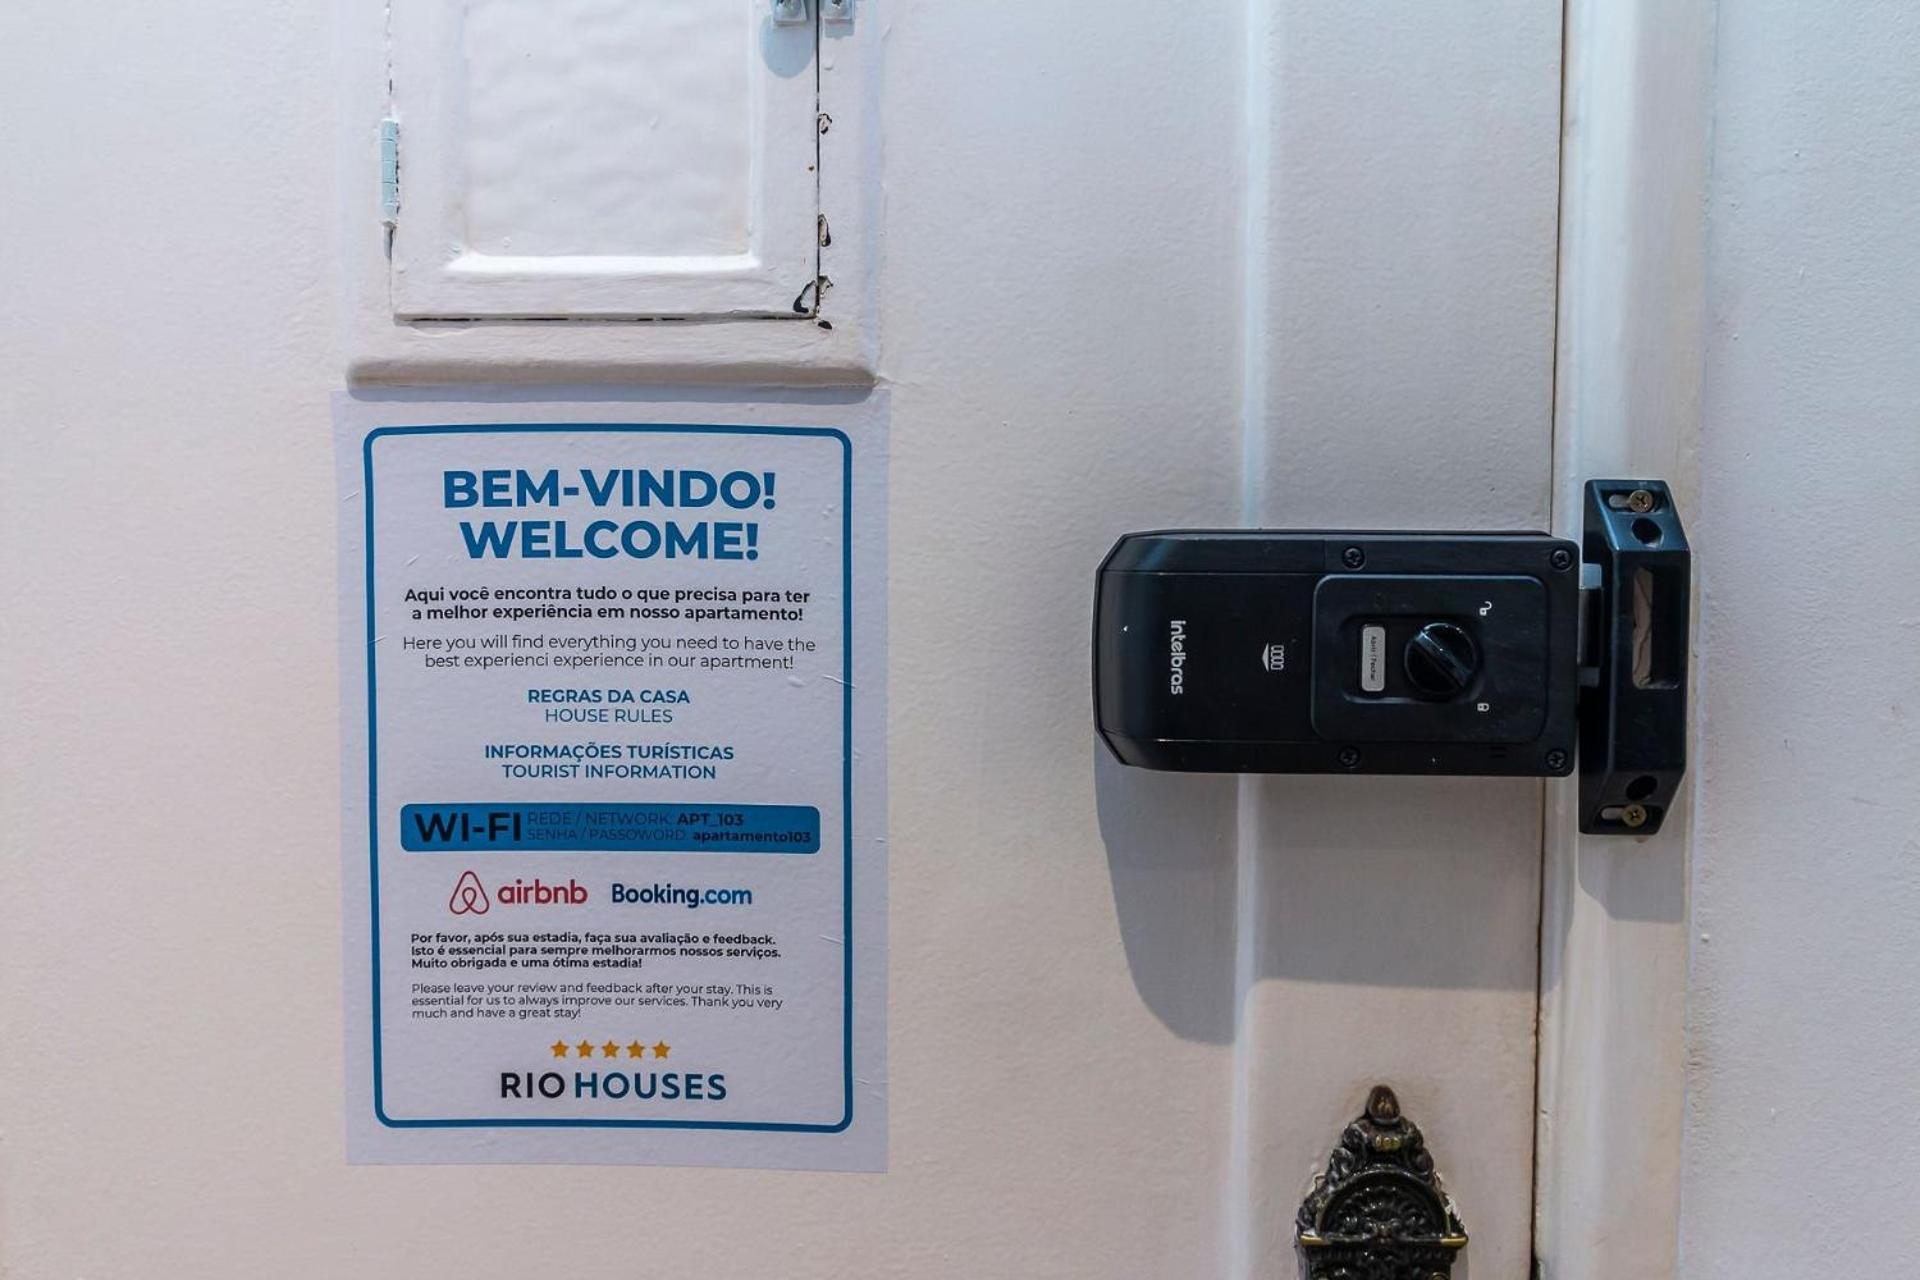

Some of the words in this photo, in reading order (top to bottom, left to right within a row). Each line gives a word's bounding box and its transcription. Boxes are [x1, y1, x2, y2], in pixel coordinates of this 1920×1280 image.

[444, 470, 775, 509] BEM-VINDO!
[460, 520, 758, 560] WELCOME!
[405, 587, 444, 604] Aqui
[449, 587, 489, 600] você
[495, 588, 571, 599] encontra
[576, 586, 617, 599] tudo
[622, 590, 632, 599] o
[637, 590, 670, 603] que
[675, 587, 736, 603] precisa
[743, 591, 780, 604] para
[785, 591, 810, 603] ter
[412, 610, 421, 619] a
[427, 605, 488, 619] melhor
[493, 604, 592, 621] experiência
[598, 608, 624, 618] em
[630, 608, 680, 618] nosso
[685, 607, 802, 622] apartamento!
[404, 637, 442, 649] Here
[446, 639, 475, 652] you
[480, 635, 507, 648] will
[512, 635, 543, 648] find
[549, 635, 636, 652] everything
[641, 638, 671, 652] you
[677, 636, 717, 649] need
[722, 638, 739, 649] to
[745, 636, 783, 650] have
[788, 637, 815, 651] the
[426, 654, 460, 667] best
[464, 653, 548, 670] experienci
[554, 653, 644, 669] experience
[649, 653, 663, 666] in
[668, 656, 696, 667] our
[701, 656, 793, 670] apartment!
[1170, 620, 1186, 695] intelbras
[529, 689, 602, 703] REGRAS
[608, 690, 635, 703] DA
[640, 690, 690, 703] CASA
[546, 709, 608, 722] HOUSE
[615, 709, 672, 723] RULES
[486, 742, 622, 762] INFORMAÇÕES
[627, 742, 734, 759] TURÍSTICAS
[502, 765, 580, 778] TOURIST
[586, 765, 715, 779] INFORMATION
[415, 813, 521, 841] WI-FI
[677, 814, 743, 827] APT_103
[527, 829, 576, 840] SENHA
[498, 879, 588, 904] airbnb
[612, 883, 752, 908] Booking.com
[411, 934, 432, 943] Por
[436, 933, 471, 944] favor,
[474, 932, 504, 944] após
[533, 932, 581, 944] estadia,
[585, 932, 611, 945] faça
[640, 933, 699, 946] avaliação
[702, 936, 710, 944] e
[713, 934, 775, 944] feedback.
[412, 946, 434, 956] Isto
[437, 945, 445, 955] é
[448, 944, 506, 955] essencial
[510, 947, 537, 957] para
[541, 947, 588, 959] sempre
[592, 945, 676, 955] melhorarmos
[680, 948, 723, 956] nossos
[727, 946, 781, 959] serviços.
[412, 958, 447, 968] Muito
[451, 957, 506, 969] obrigada
[553, 956, 589, 967] ótima
[593, 957, 642, 968] estadia!
[412, 984, 451, 993] Please
[454, 983, 484, 992] leave
[487, 984, 514, 995] your
[518, 983, 557, 992] review
[560, 983, 583, 992] and
[586, 983, 642, 993] feedback
[646, 983, 673, 993] after
[676, 986, 703, 996] your
[706, 985, 733, 996] stay.
[736, 984, 761, 995] This
[764, 985, 772, 995] is
[412, 995, 464, 1006] essential
[467, 995, 483, 1005] for
[486, 997, 500, 1005] us
[503, 996, 515, 1005] to
[518, 995, 559, 1007] always
[562, 995, 612, 1007] improve
[638, 995, 688, 1006] services.
[691, 996, 729, 1006] Thank
[732, 999, 754, 1009] you
[757, 999, 783, 1010] very
[412, 1008, 447, 1018] much
[450, 1008, 474, 1018] and
[477, 1007, 506, 1017] have
[509, 1010, 516, 1018] a
[519, 1009, 550, 1019] great
[554, 1008, 581, 1020] stay!
[501, 1072, 565, 1098] RIO
[575, 1073, 726, 1100] HOUSES
